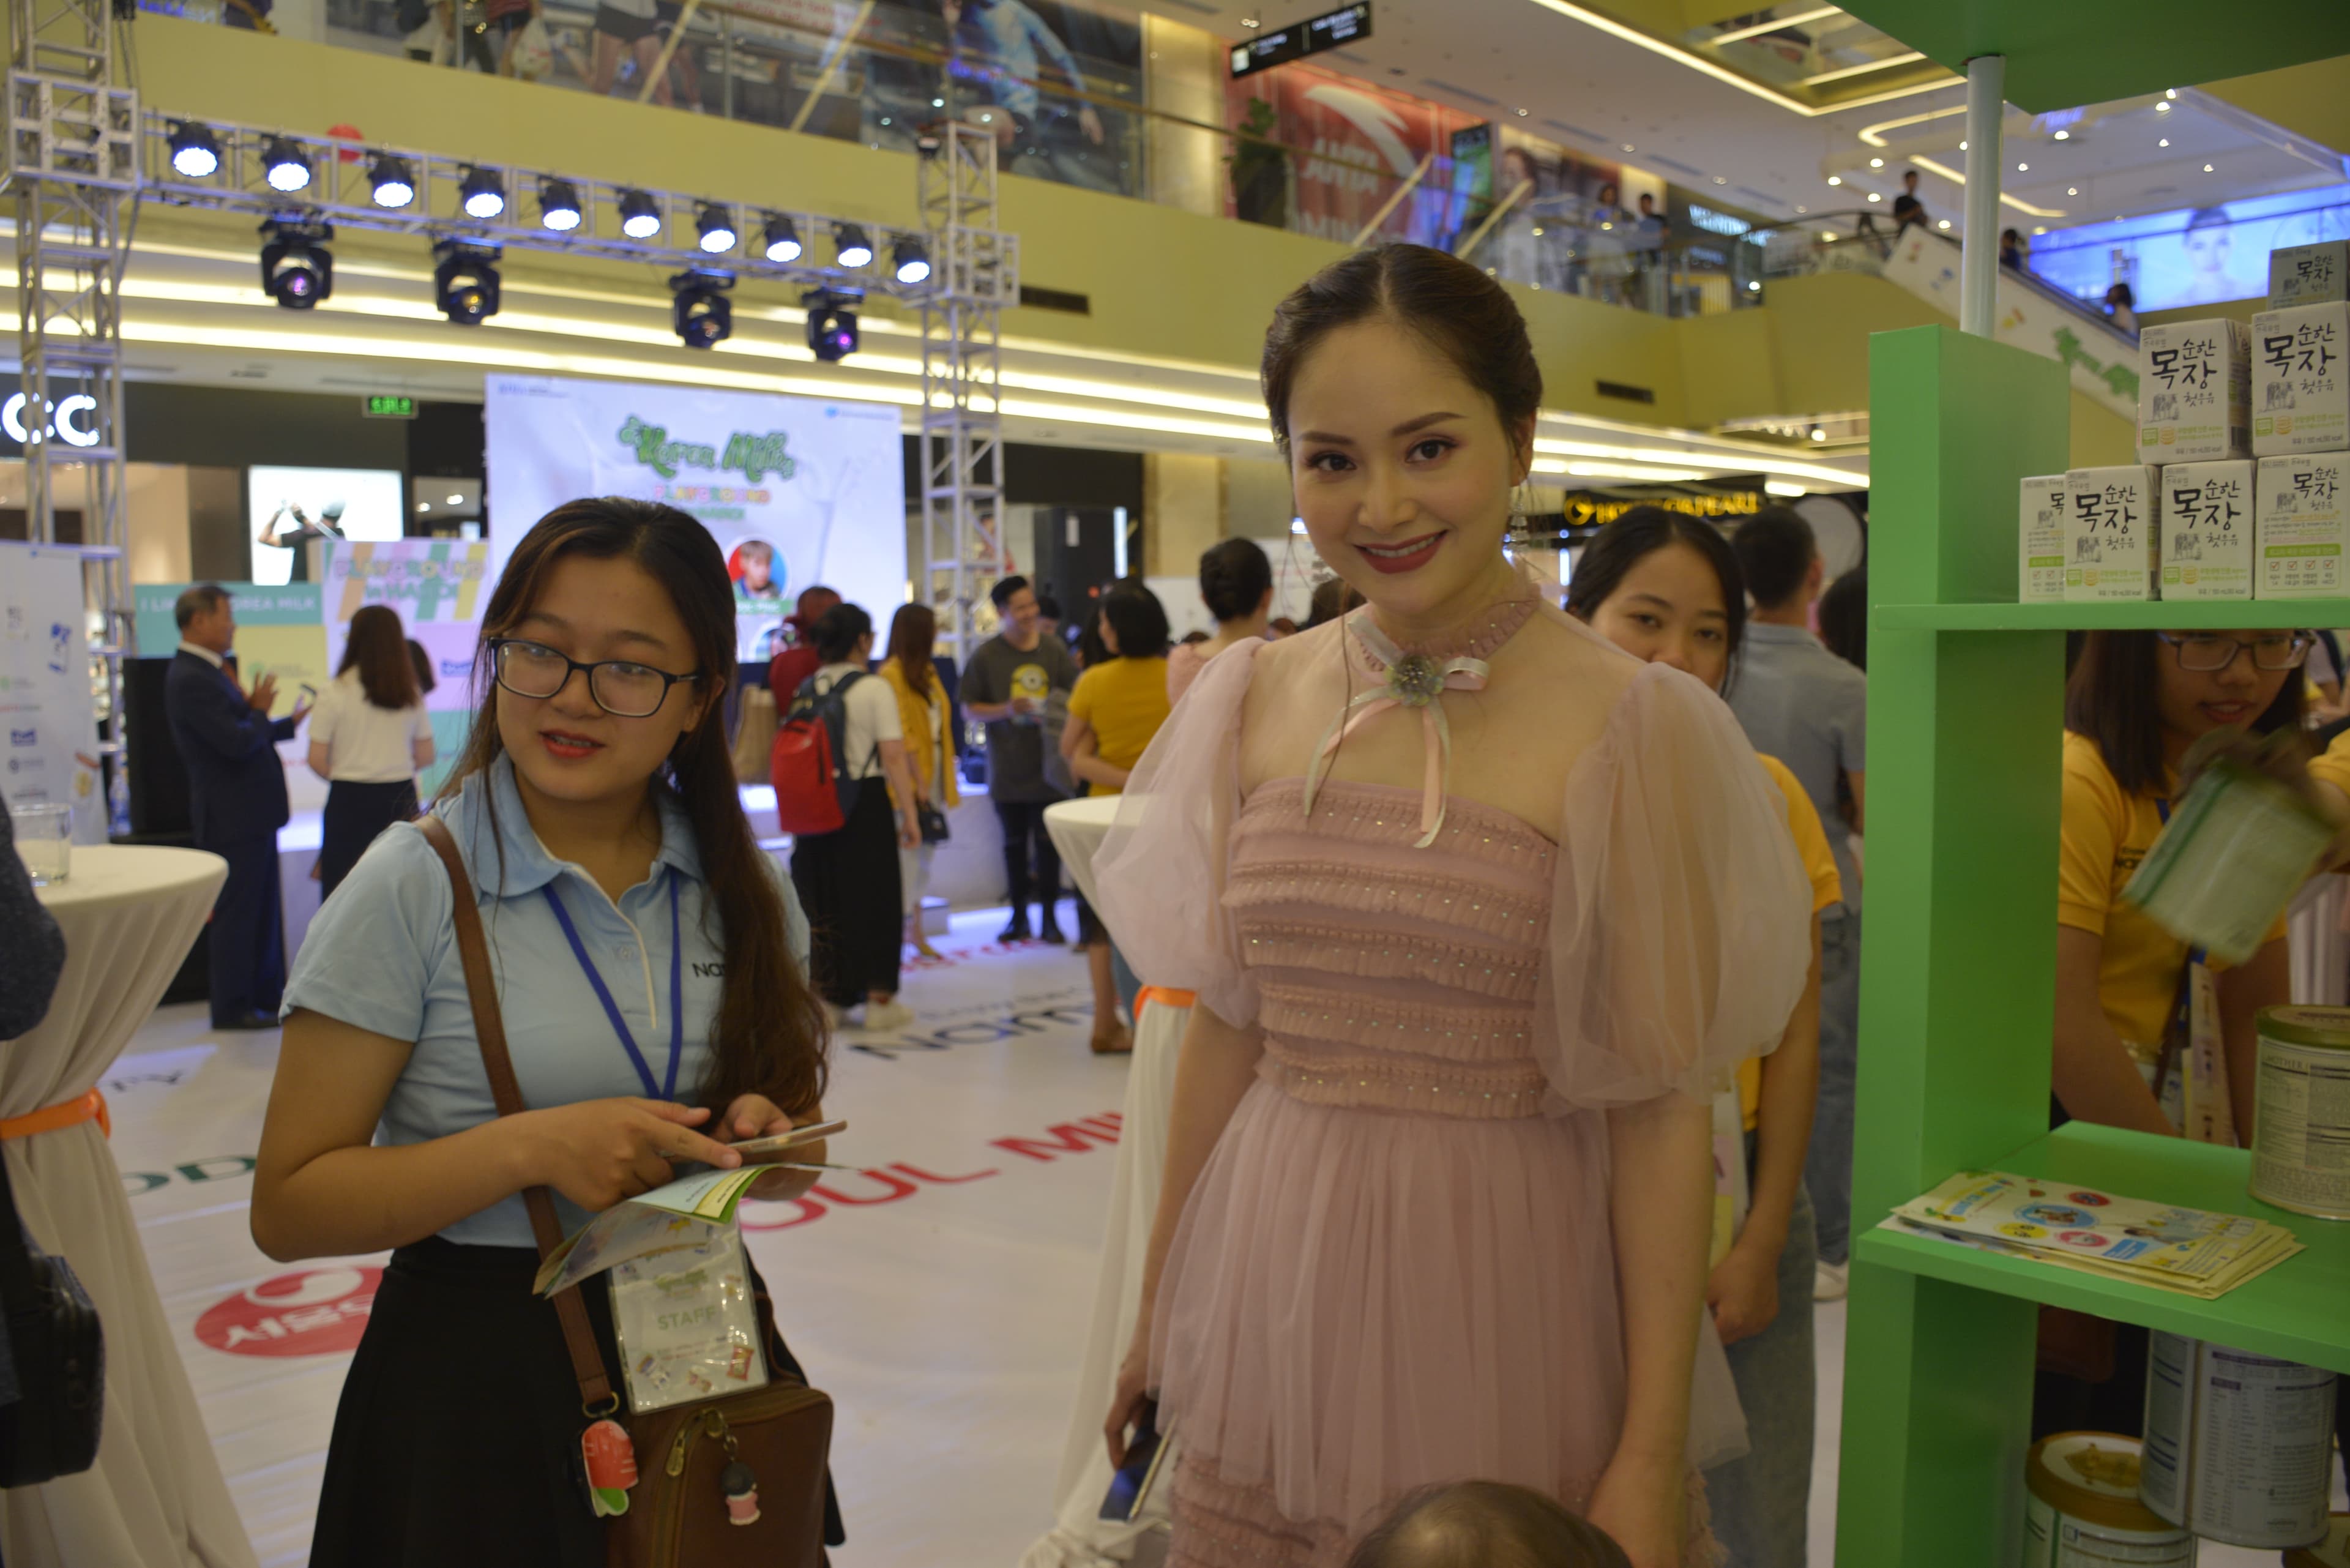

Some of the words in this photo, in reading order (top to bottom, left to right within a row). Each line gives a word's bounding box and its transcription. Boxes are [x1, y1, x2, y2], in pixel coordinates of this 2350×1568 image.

[1302, 137, 1379, 196] ANTA
[2298, 323, 2336, 346] 순한
[2182, 338, 2217, 360] 순한
[2264, 335, 2337, 377] 목장
[2151, 349, 2218, 390] 목장
[2293, 473, 2339, 500] 목장
[2315, 466, 2339, 481] 순한
[2105, 483, 2137, 505] 순한
[2205, 479, 2240, 501] 순한
[2051, 492, 2064, 515] 목
[2075, 493, 2138, 534] 목장
[2173, 488, 2242, 531] 목장
[231, 597, 274, 611] OREA
[277, 595, 316, 610] MILK
[737, 1161, 1001, 1232] OUL
[987, 1111, 1123, 1162] MI
[657, 1305, 716, 1331] STAFF
